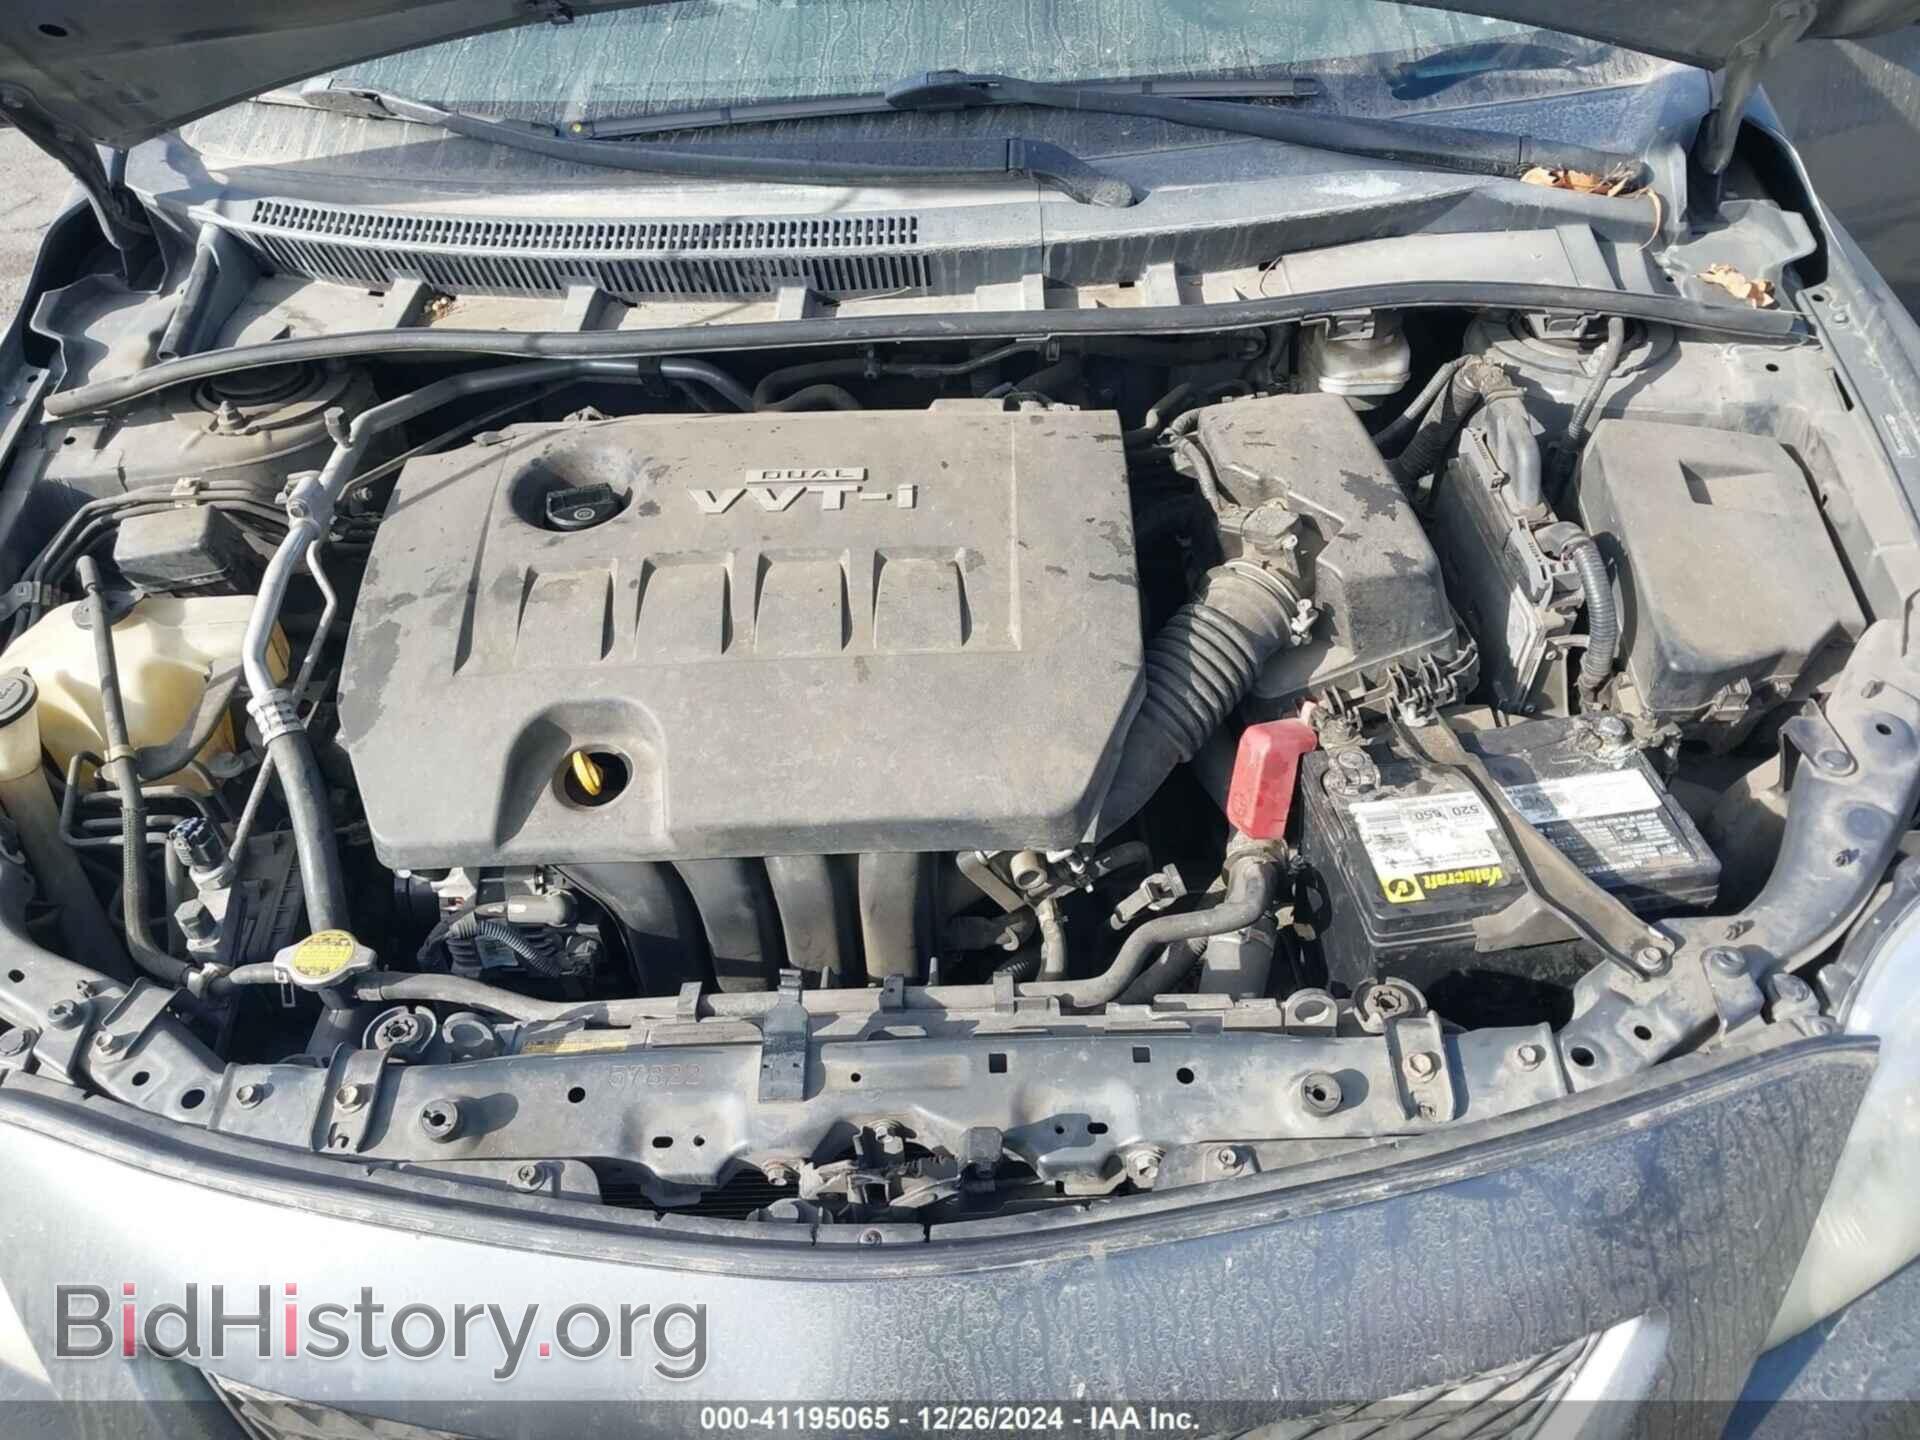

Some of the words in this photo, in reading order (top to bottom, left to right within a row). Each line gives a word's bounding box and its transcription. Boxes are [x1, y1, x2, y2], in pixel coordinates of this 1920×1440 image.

[759, 468, 858, 481] DUAL
[1453, 805, 1480, 817] 520
[1423, 867, 1503, 889] Valucraft
